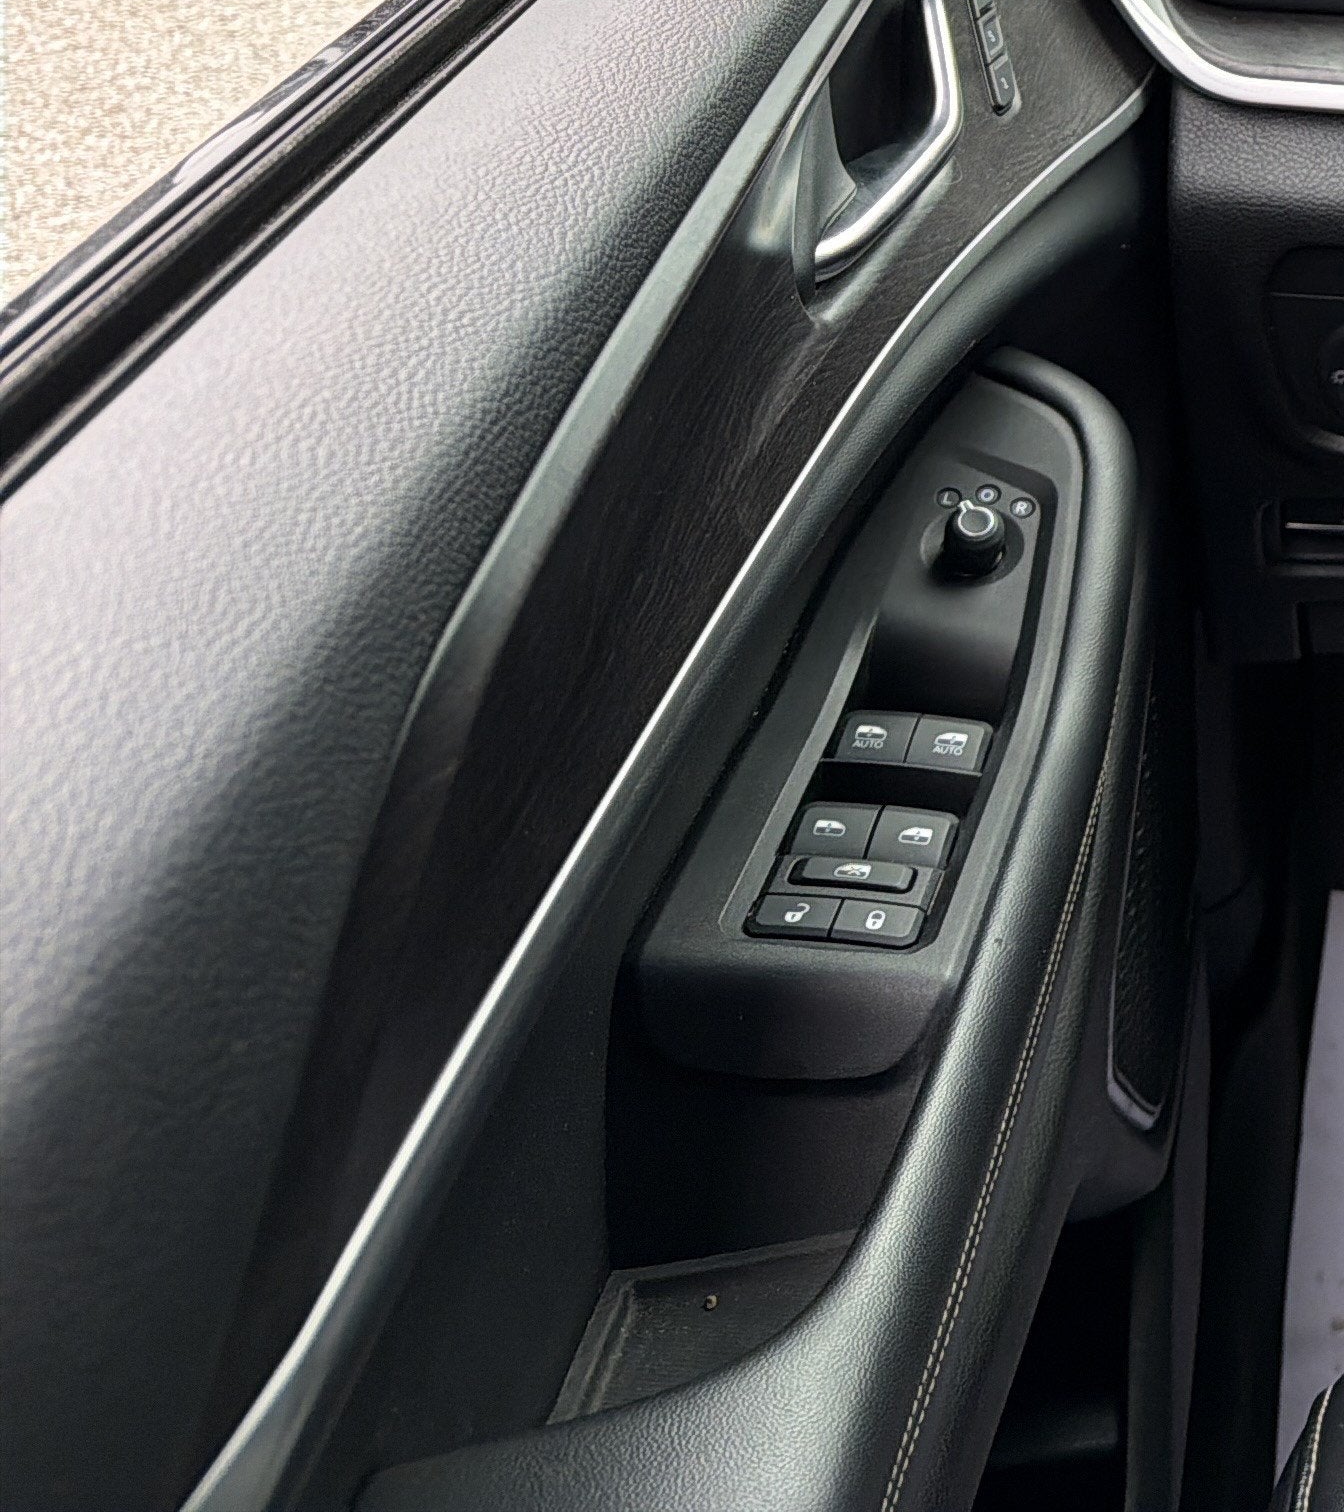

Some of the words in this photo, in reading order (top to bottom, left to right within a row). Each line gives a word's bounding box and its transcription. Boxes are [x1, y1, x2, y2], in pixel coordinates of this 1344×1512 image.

[942, 490, 953, 505] L
[1015, 500, 1028, 516] R
[852, 739, 885, 750] AUTO
[932, 745, 963, 757] AUTO
